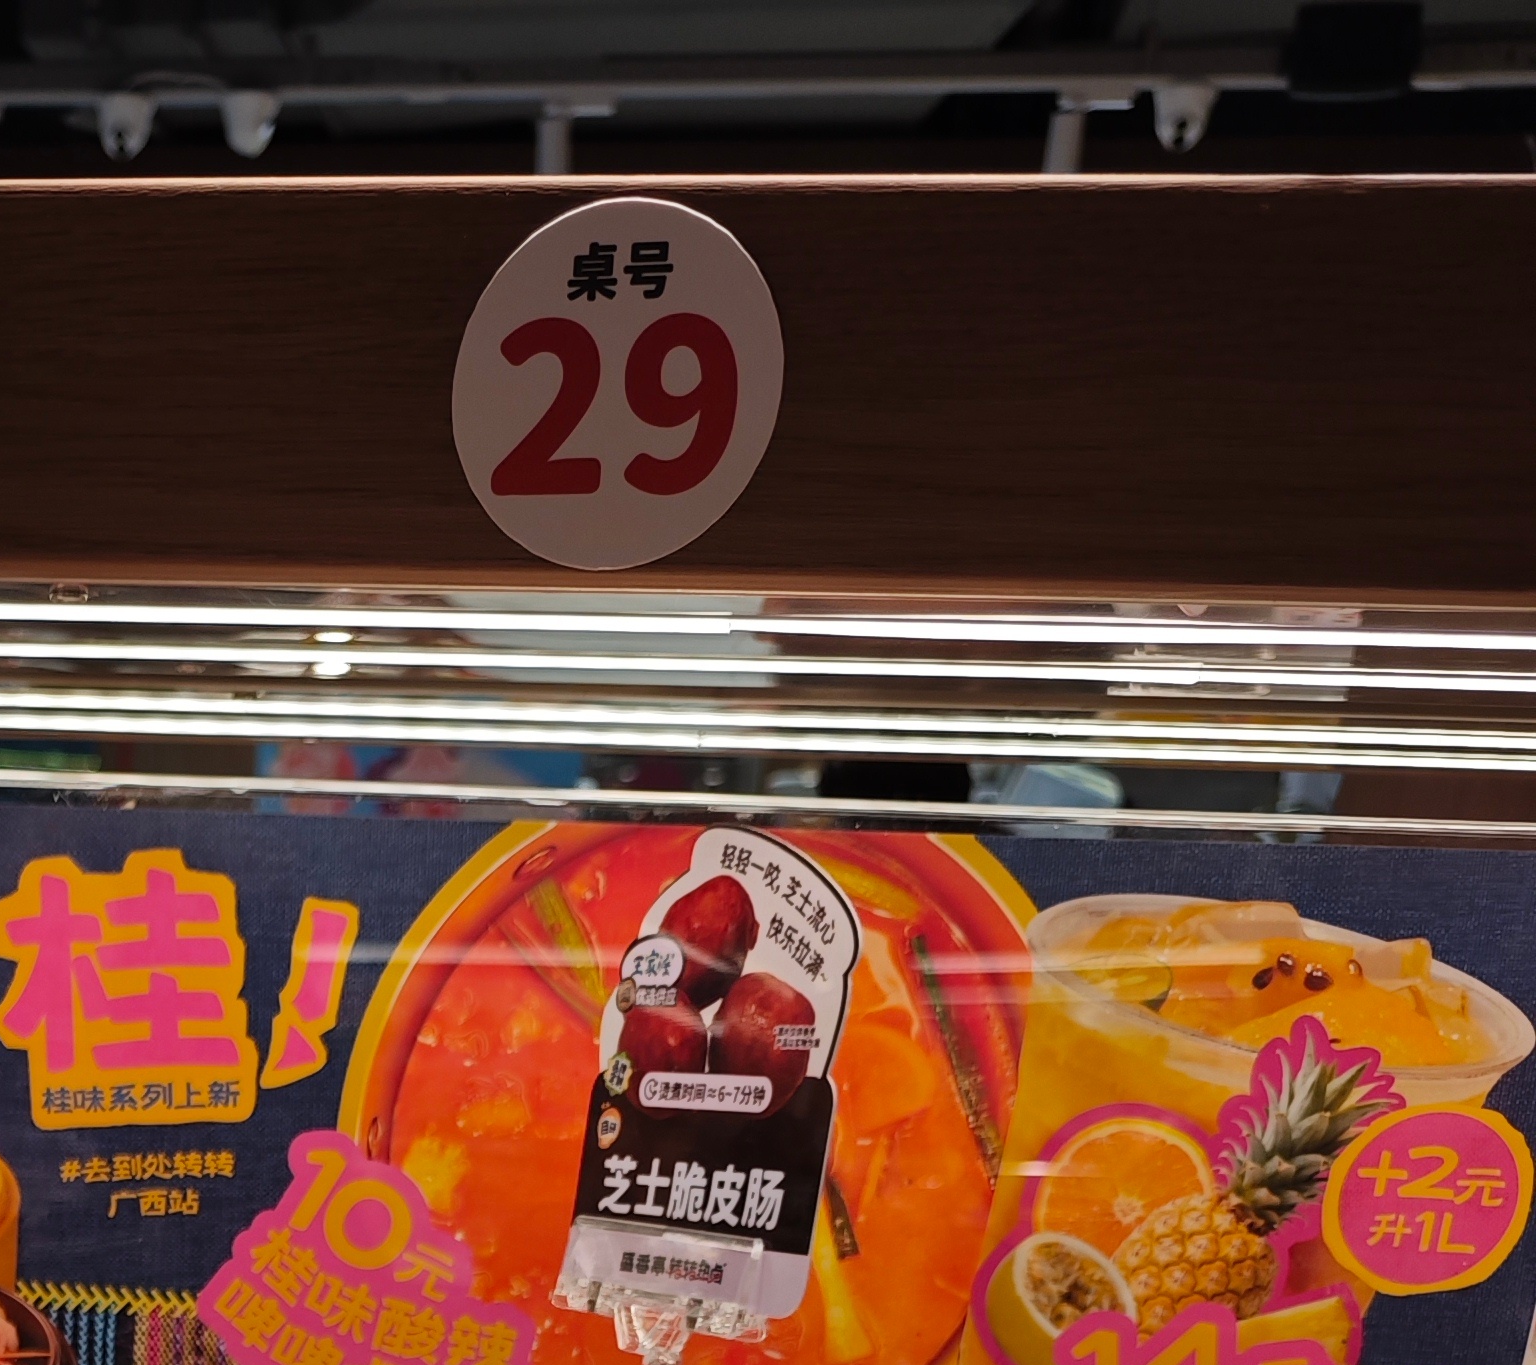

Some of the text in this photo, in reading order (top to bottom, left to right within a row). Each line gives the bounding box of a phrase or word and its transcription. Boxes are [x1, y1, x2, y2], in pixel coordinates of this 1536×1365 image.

[567, 241, 674, 301] 桌号
[490, 312, 738, 496] 29
[41, 1081, 240, 1116] 桂味系列上新
[60, 1150, 236, 1184] #去到处转转
[597, 1154, 785, 1231] 芝士脆皮肠
[1358, 1145, 1507, 1207] +2元
[108, 1189, 200, 1219] 广西站
[287, 1148, 457, 1303] 10元
[1368, 1211, 1476, 1255] 升1L
